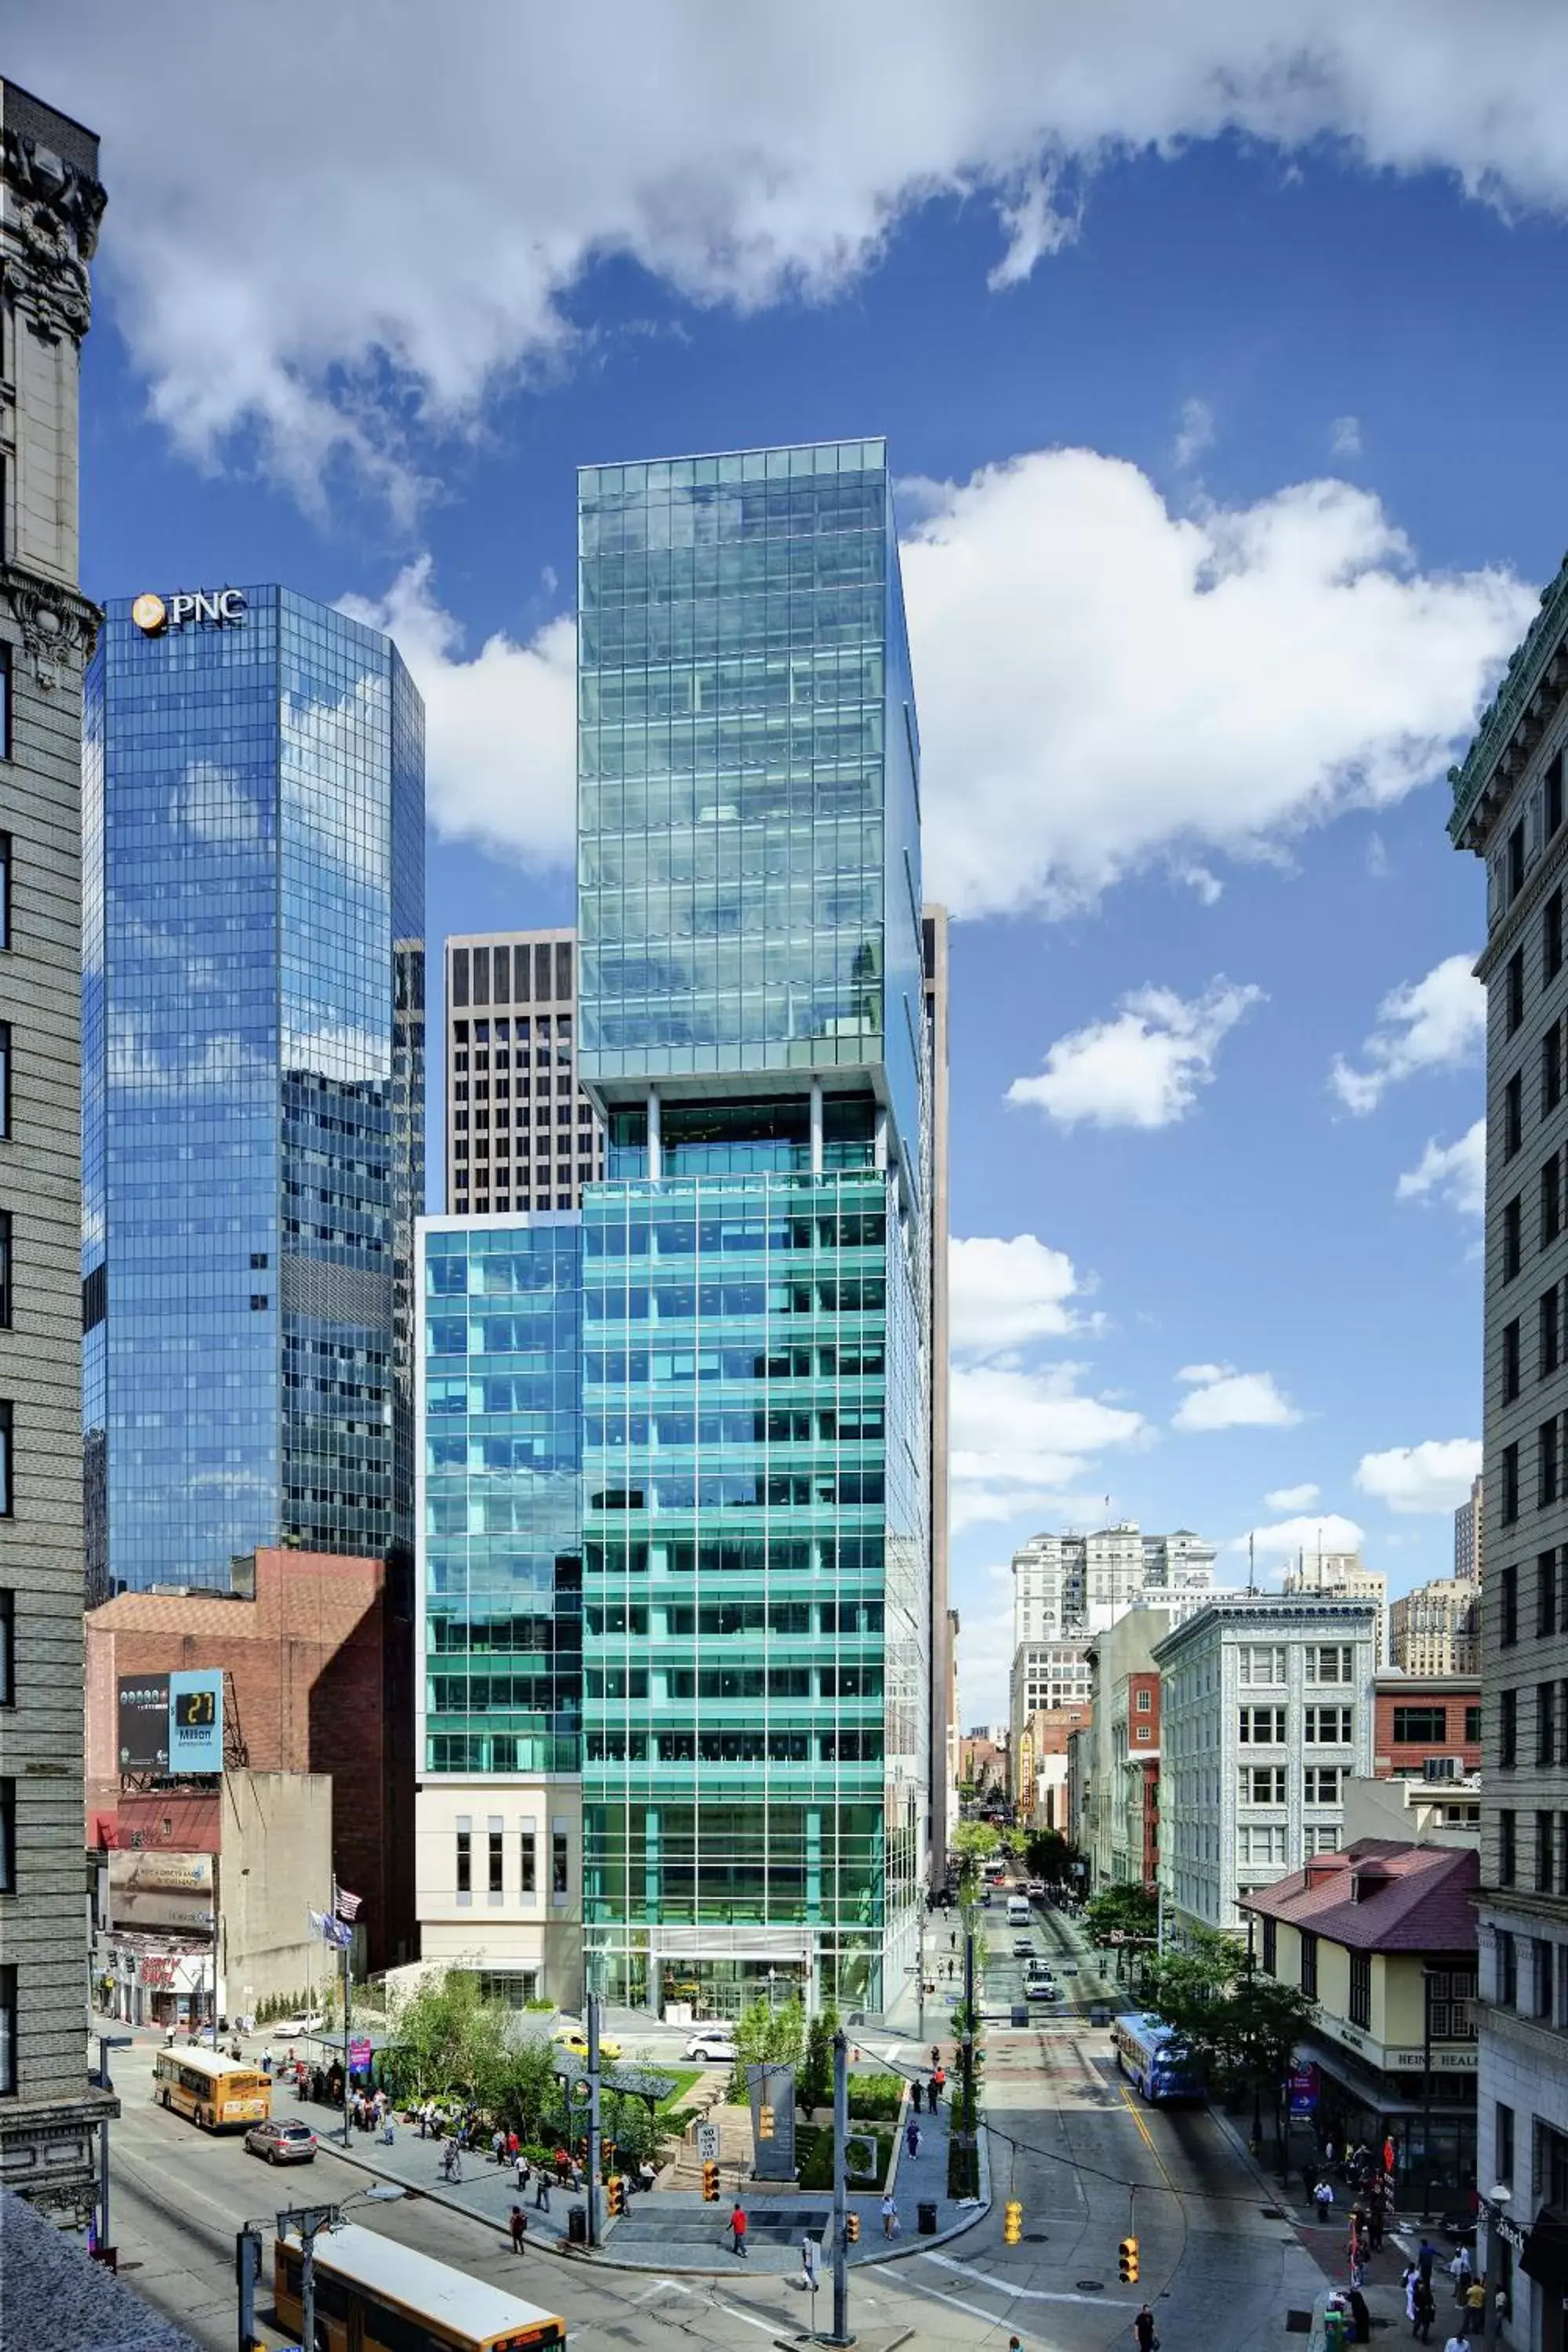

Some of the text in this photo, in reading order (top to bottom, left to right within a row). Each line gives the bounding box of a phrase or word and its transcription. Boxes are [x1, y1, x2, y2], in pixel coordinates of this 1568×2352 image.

[169, 589, 243, 624] PNC
[187, 1693, 213, 1724] 27
[702, 2128, 714, 2136] NO
